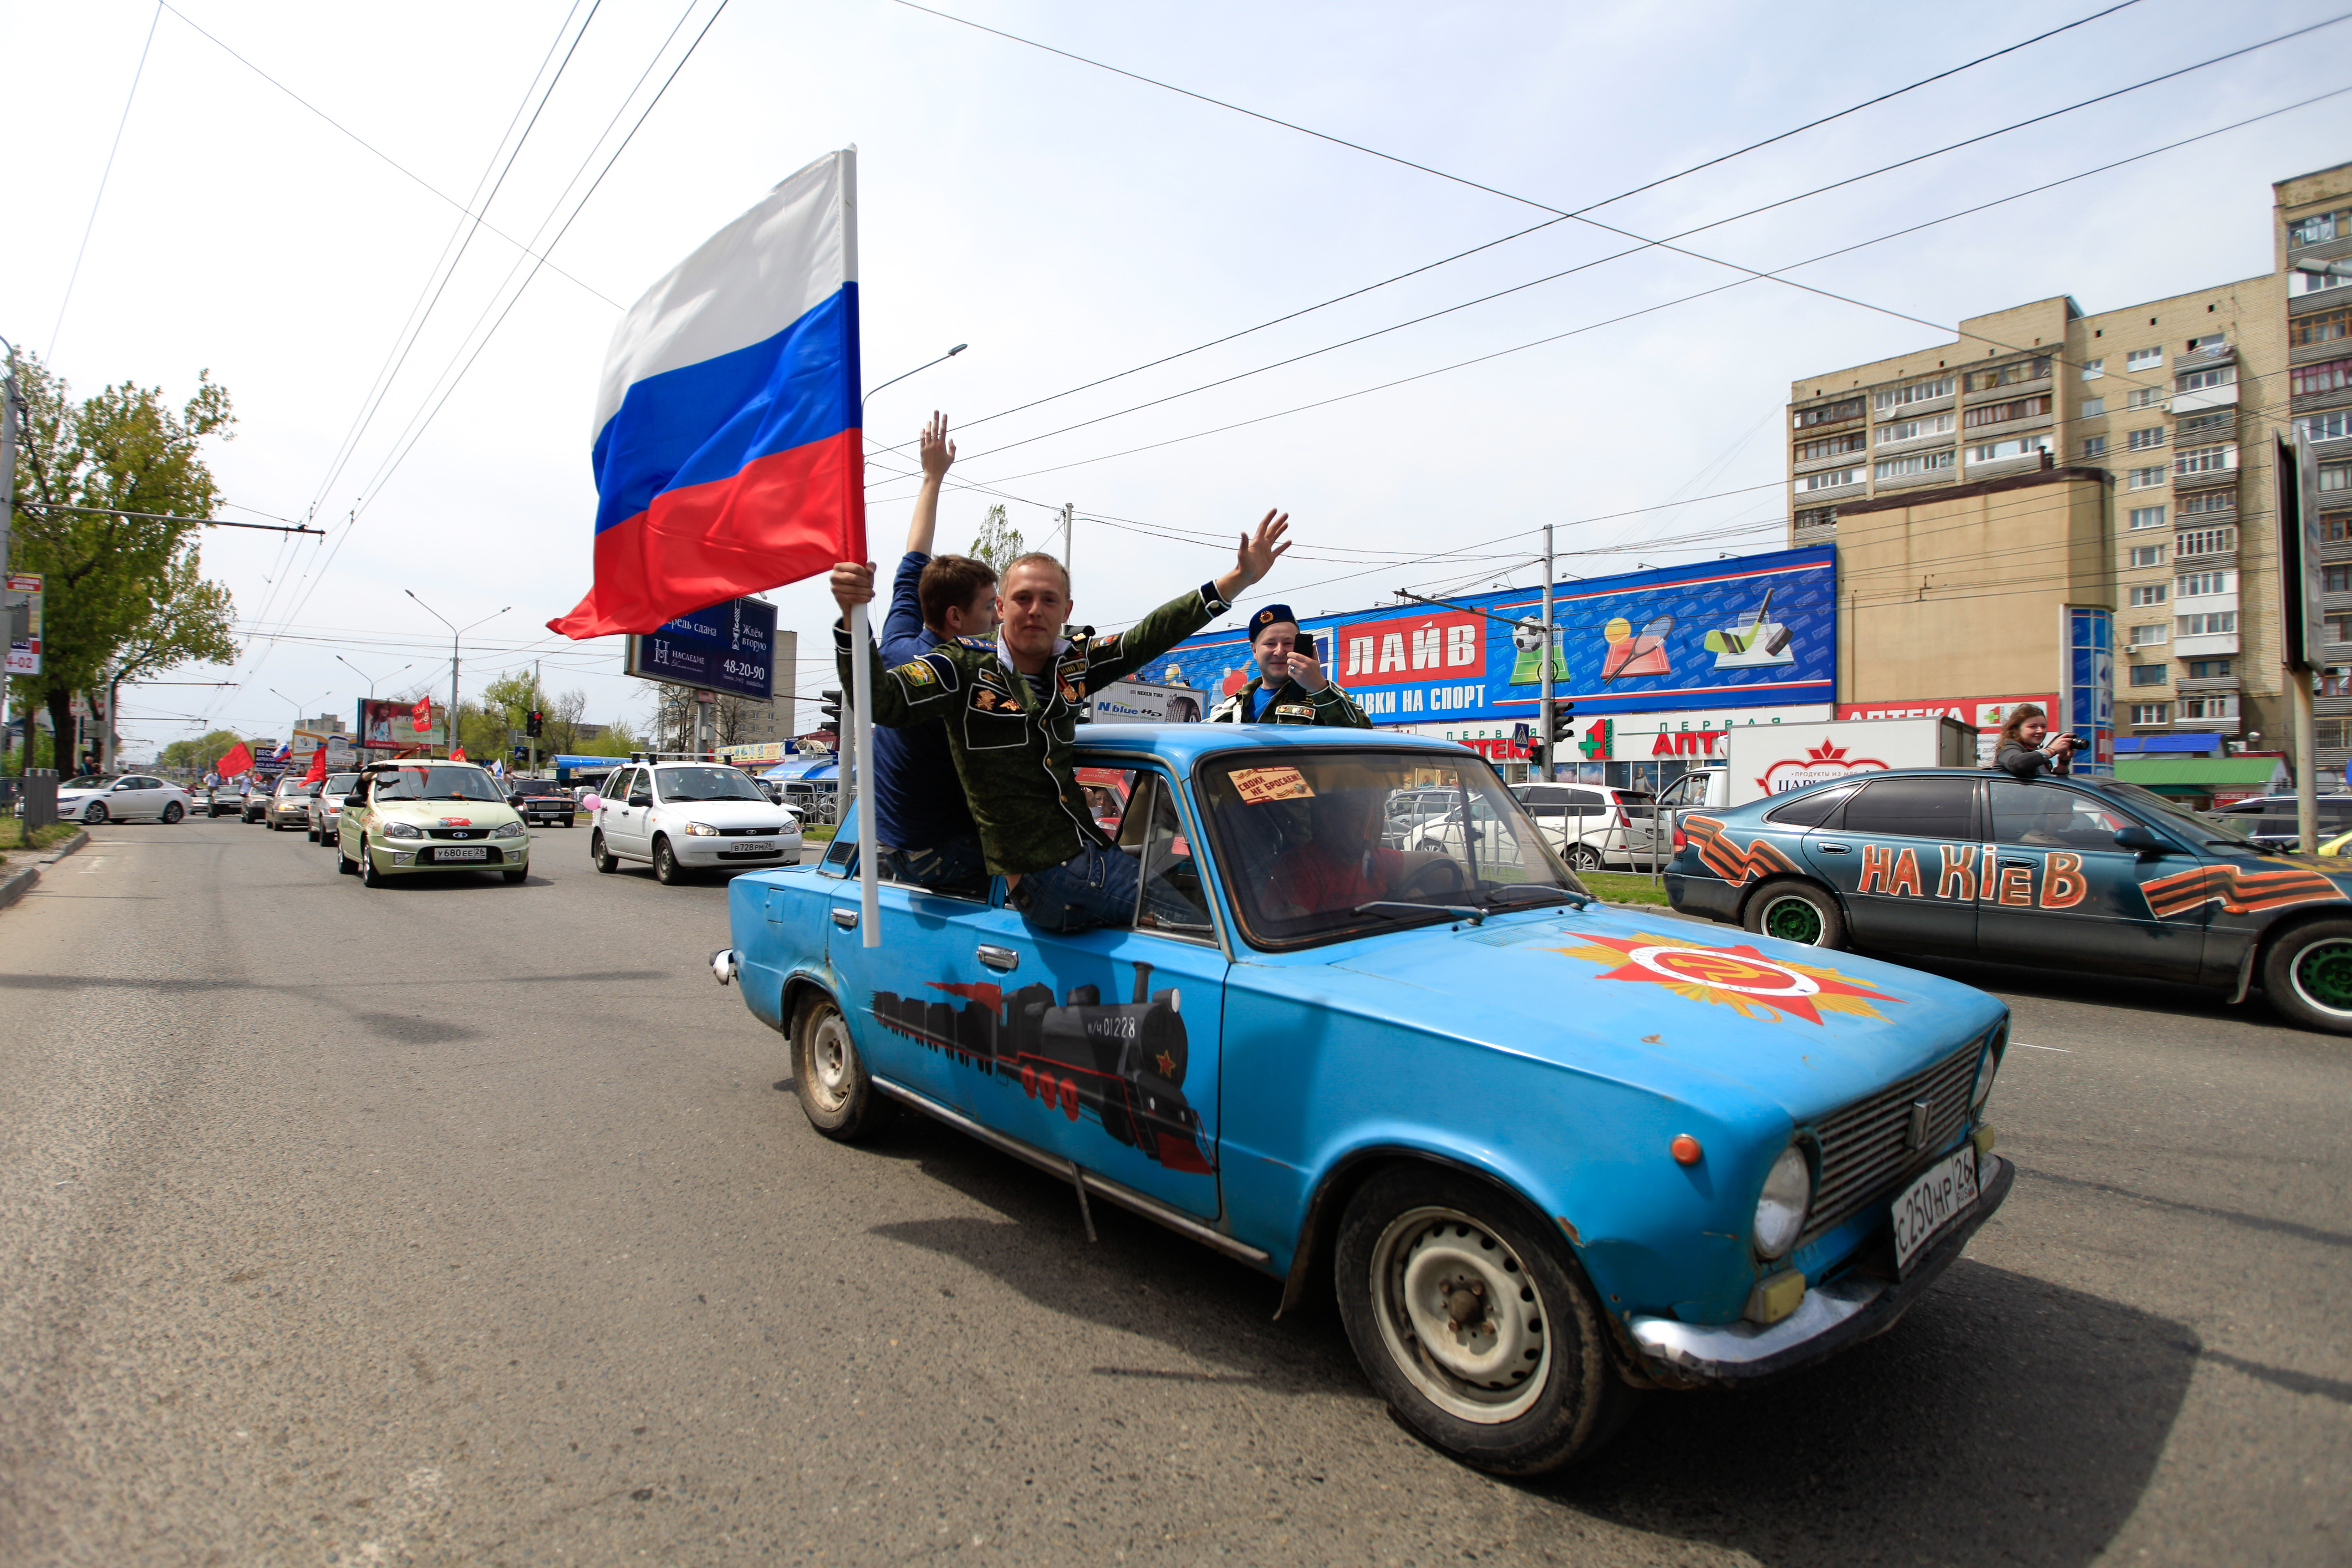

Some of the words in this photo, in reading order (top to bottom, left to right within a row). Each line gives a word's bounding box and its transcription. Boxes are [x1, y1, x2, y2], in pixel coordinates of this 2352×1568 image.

[694, 623, 716, 637] сдана
[743, 624, 763, 638] Ждём
[742, 638, 766, 652] вторую
[1346, 620, 1475, 676] ЛАЙВ
[673, 650, 704, 664] НАСЛЕДИЕ
[724, 659, 765, 680] 48-20-90
[1402, 689, 1424, 712] НА
[1430, 684, 1486, 710] СПОРТ
[1112, 705, 1138, 715] blue
[1447, 728, 1537, 741] ПЕРВЯ
[1604, 718, 1612, 756] АПТЕКА
[1238, 776, 1266, 792] СВОИХ
[1250, 786, 1264, 796] НЕ
[1264, 773, 1301, 791] БРОСАЕМ!
[1857, 844, 1924, 897] НА
[1104, 1016, 1136, 1039] 01228
[1956, 1152, 1973, 1189] 26
[1957, 1187, 1968, 1203] RUS
